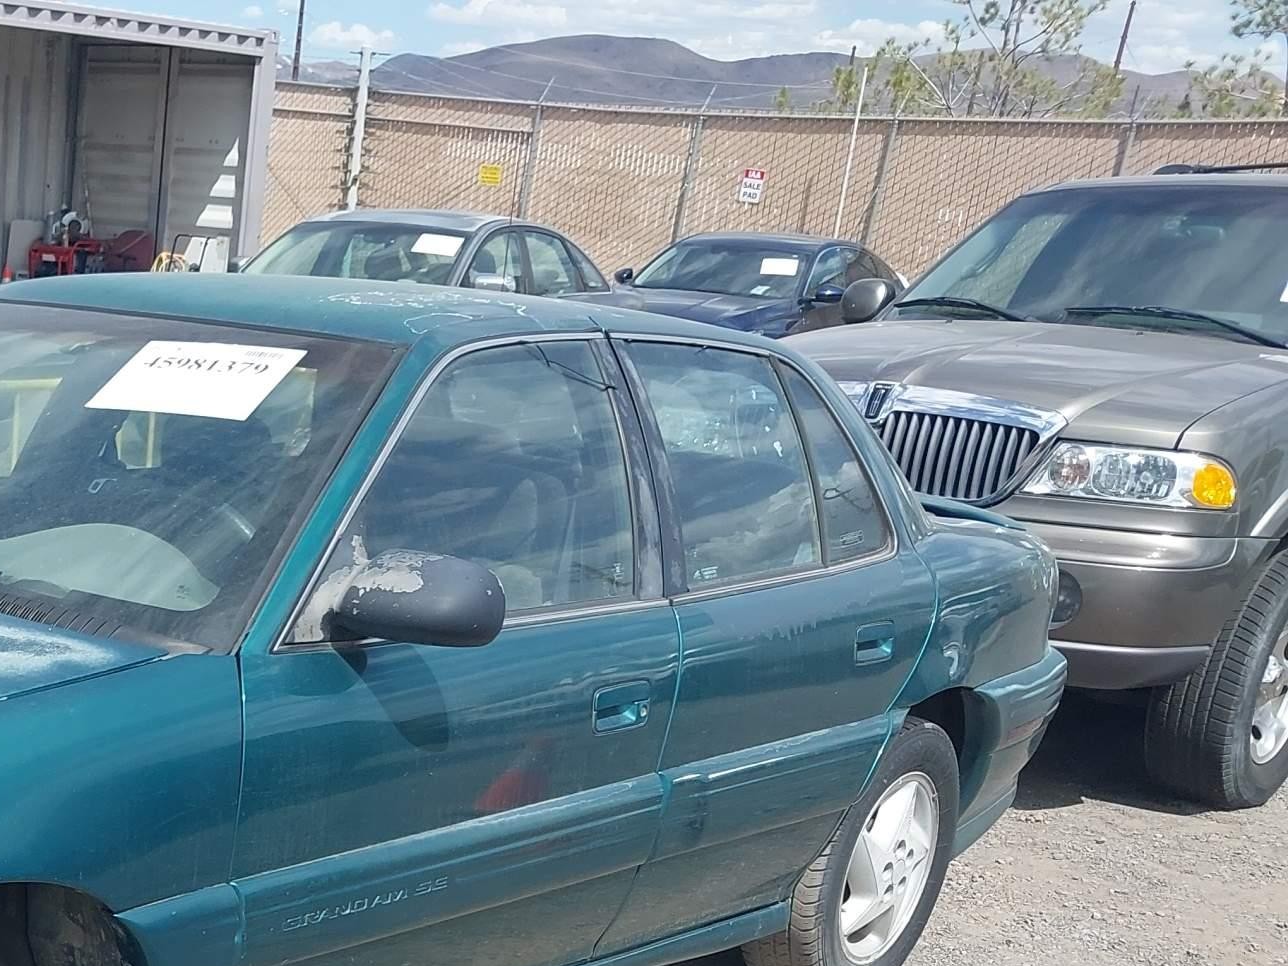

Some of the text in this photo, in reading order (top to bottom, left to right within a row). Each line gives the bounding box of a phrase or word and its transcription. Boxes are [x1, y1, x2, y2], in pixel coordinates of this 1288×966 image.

[743, 181, 762, 191] SALE
[742, 191, 758, 200] PAD
[144, 355, 270, 375] 45981379
[414, 876, 449, 897] SE
